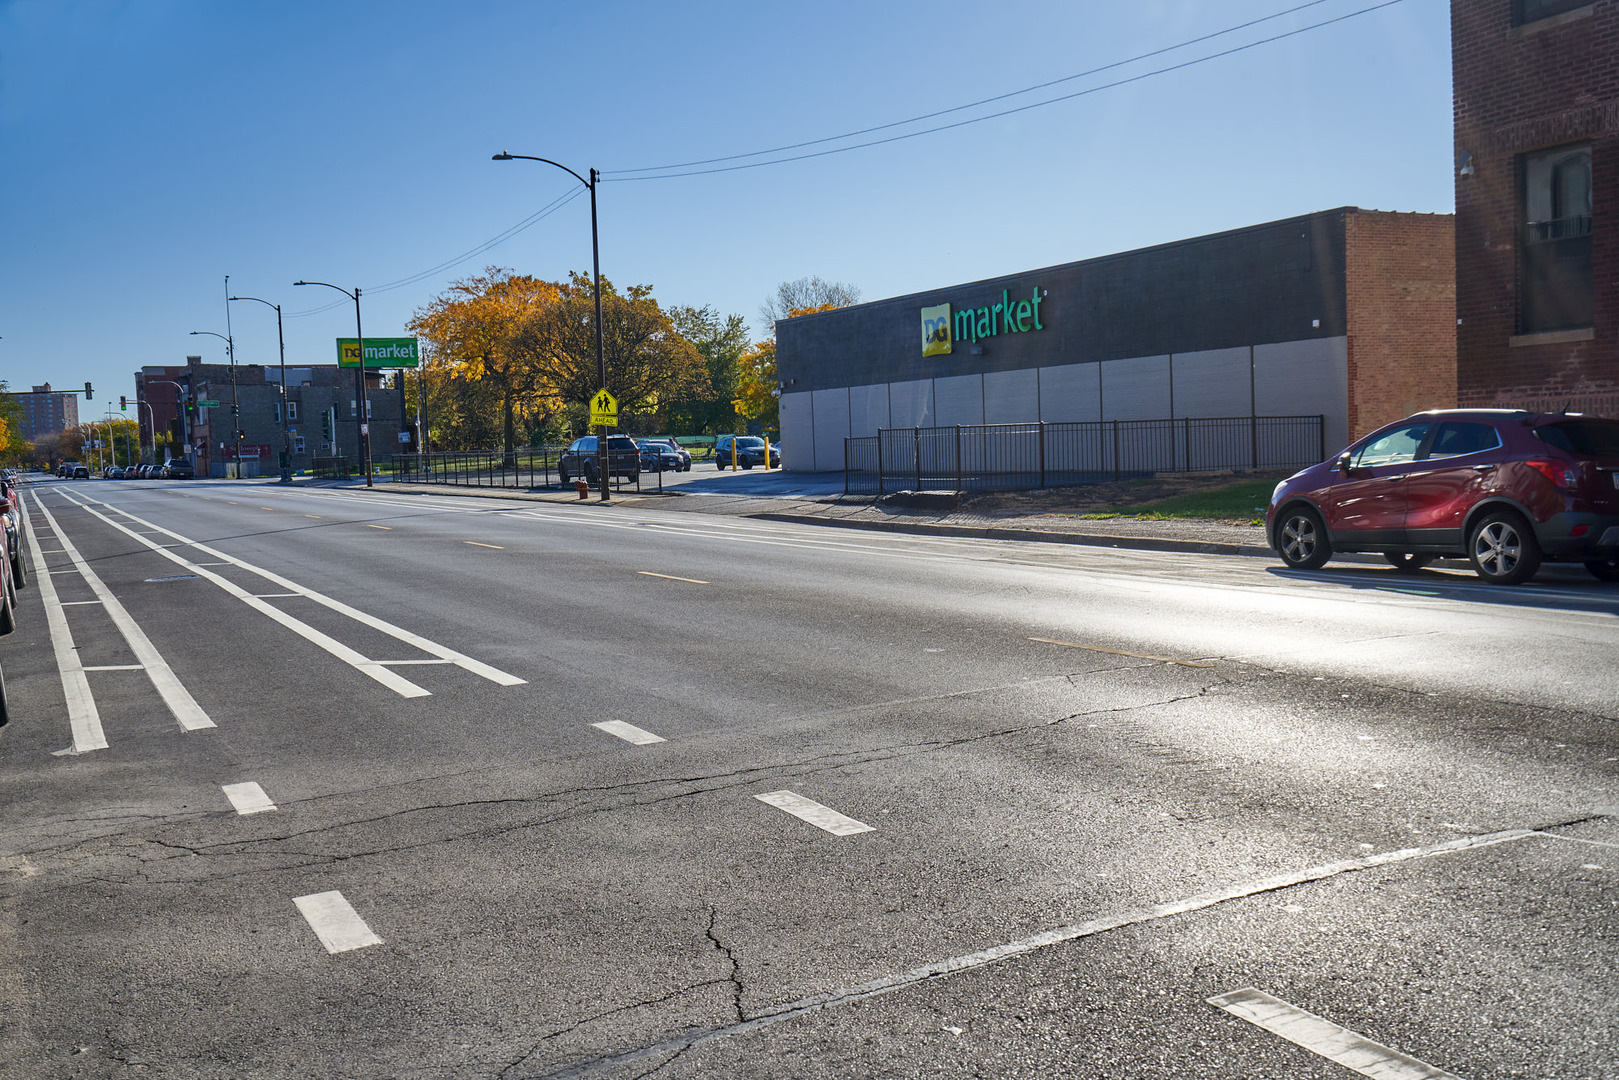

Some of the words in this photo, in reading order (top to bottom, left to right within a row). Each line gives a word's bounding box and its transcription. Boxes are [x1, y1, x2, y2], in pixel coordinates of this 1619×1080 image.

[924, 316, 948, 345] DG
[954, 286, 1043, 344] market
[344, 347, 361, 358] DG
[364, 343, 415, 359] market
